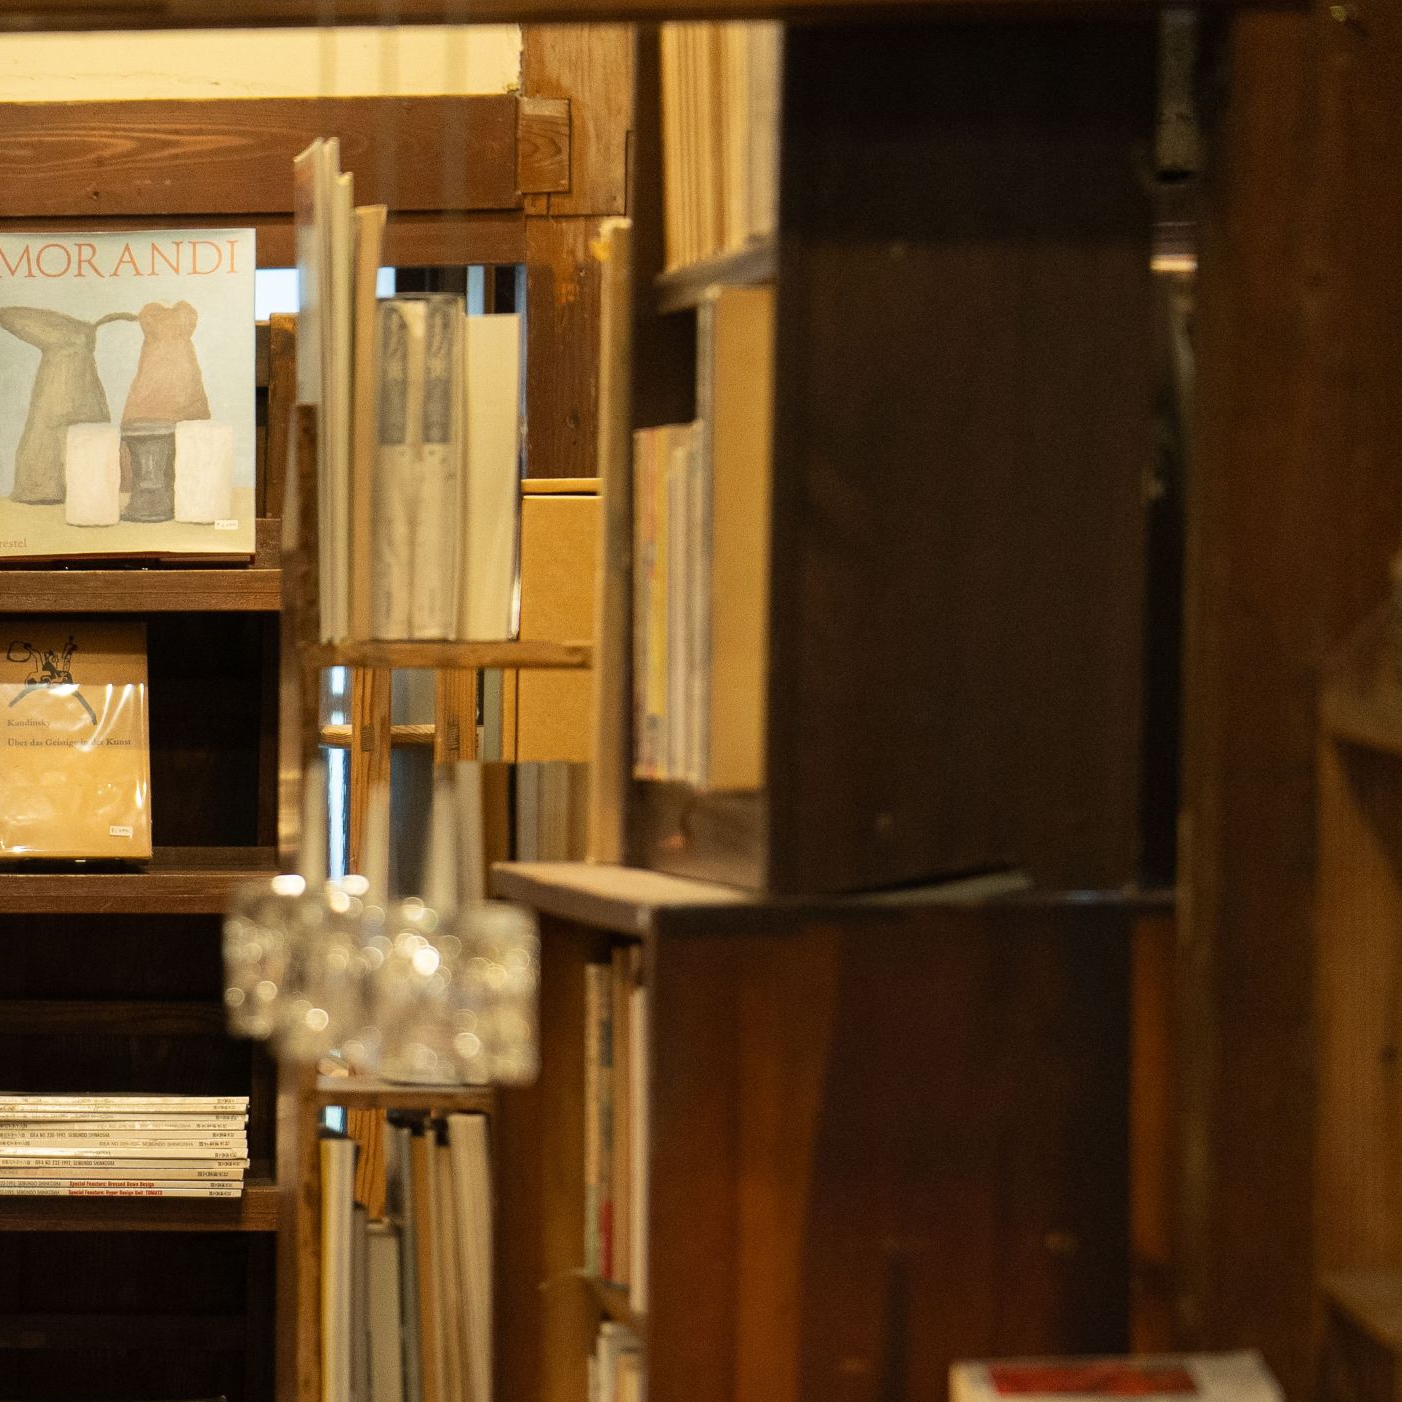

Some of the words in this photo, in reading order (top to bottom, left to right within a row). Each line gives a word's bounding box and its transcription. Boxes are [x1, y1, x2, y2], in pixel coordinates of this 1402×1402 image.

[7, 718, 52, 728] Kandinsky
[8, 738, 28, 747] Über
[30, 739, 44, 747] das
[106, 738, 132, 746] Kunst
